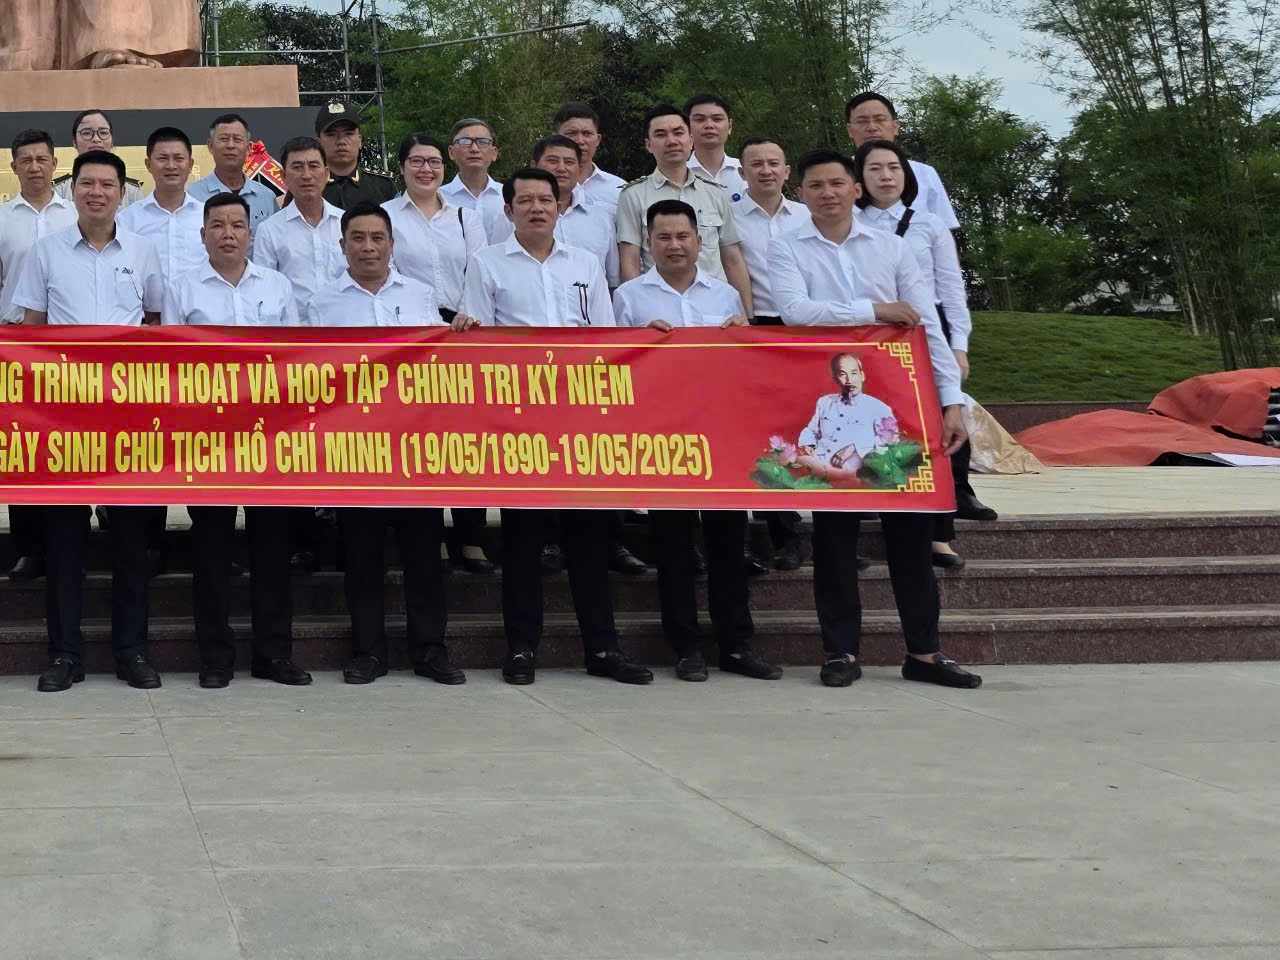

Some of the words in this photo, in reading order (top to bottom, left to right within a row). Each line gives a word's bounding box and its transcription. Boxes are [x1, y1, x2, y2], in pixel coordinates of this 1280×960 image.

[31, 354, 104, 404] TRÌNH
[111, 362, 170, 404] SINH
[178, 363, 240, 413] HOẠT
[247, 355, 280, 404] VÀ
[287, 363, 336, 413] HỌC
[342, 354, 389, 413] TẬP
[397, 354, 475, 404] CHÍNH
[480, 363, 521, 414] TRỊ
[526, 350, 558, 405] KỶ
[566, 356, 635, 415] NIỆM
[47, 431, 107, 473] SINH
[114, 417, 164, 473] CHỦ
[171, 431, 227, 482] TỊCH
[233, 417, 268, 473] HỒ
[275, 422, 317, 473] CHÍ
[324, 431, 393, 473] MINH
[400, 431, 713, 480] (19/05/1890-19/05/2025)
